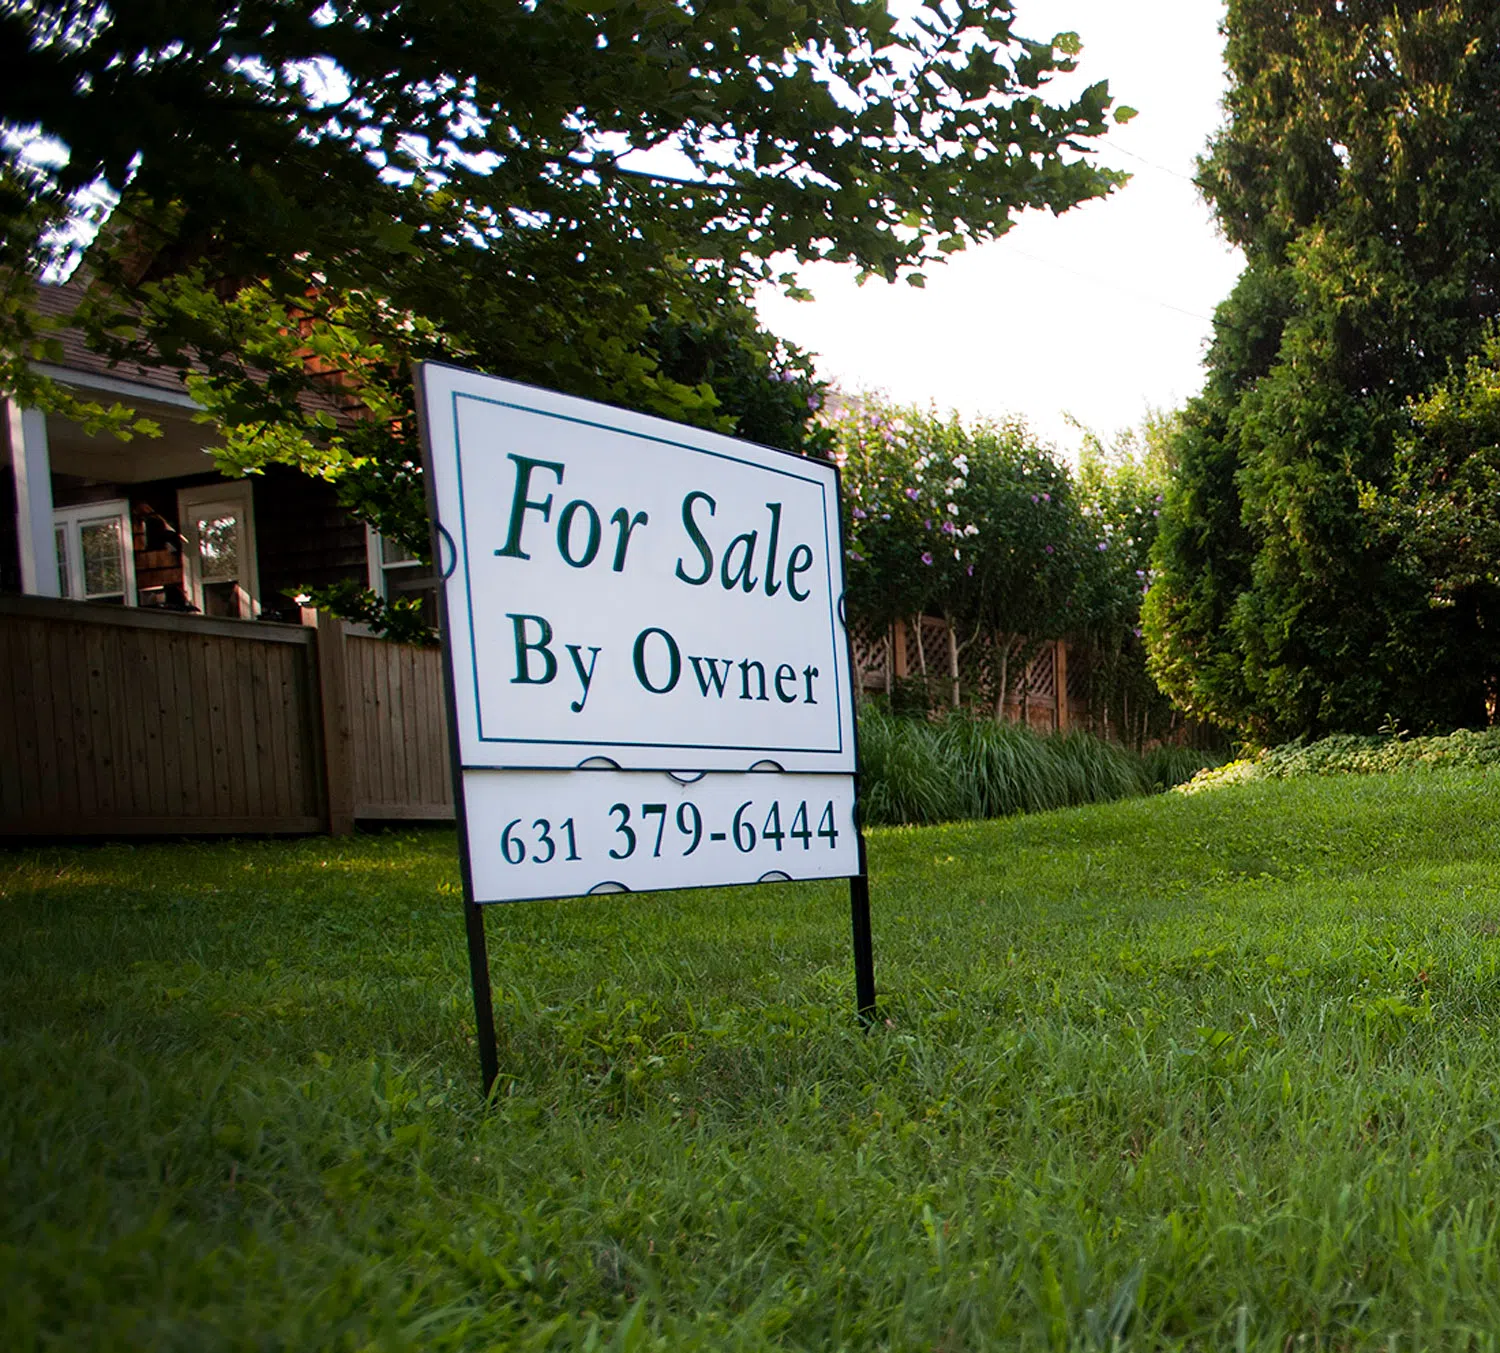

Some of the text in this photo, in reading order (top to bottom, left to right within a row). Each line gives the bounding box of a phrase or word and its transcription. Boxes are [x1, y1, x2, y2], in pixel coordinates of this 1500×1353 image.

[494, 452, 814, 602] For Sale
[505, 612, 819, 713] By Owner
[501, 800, 839, 865] 631 379-6444
